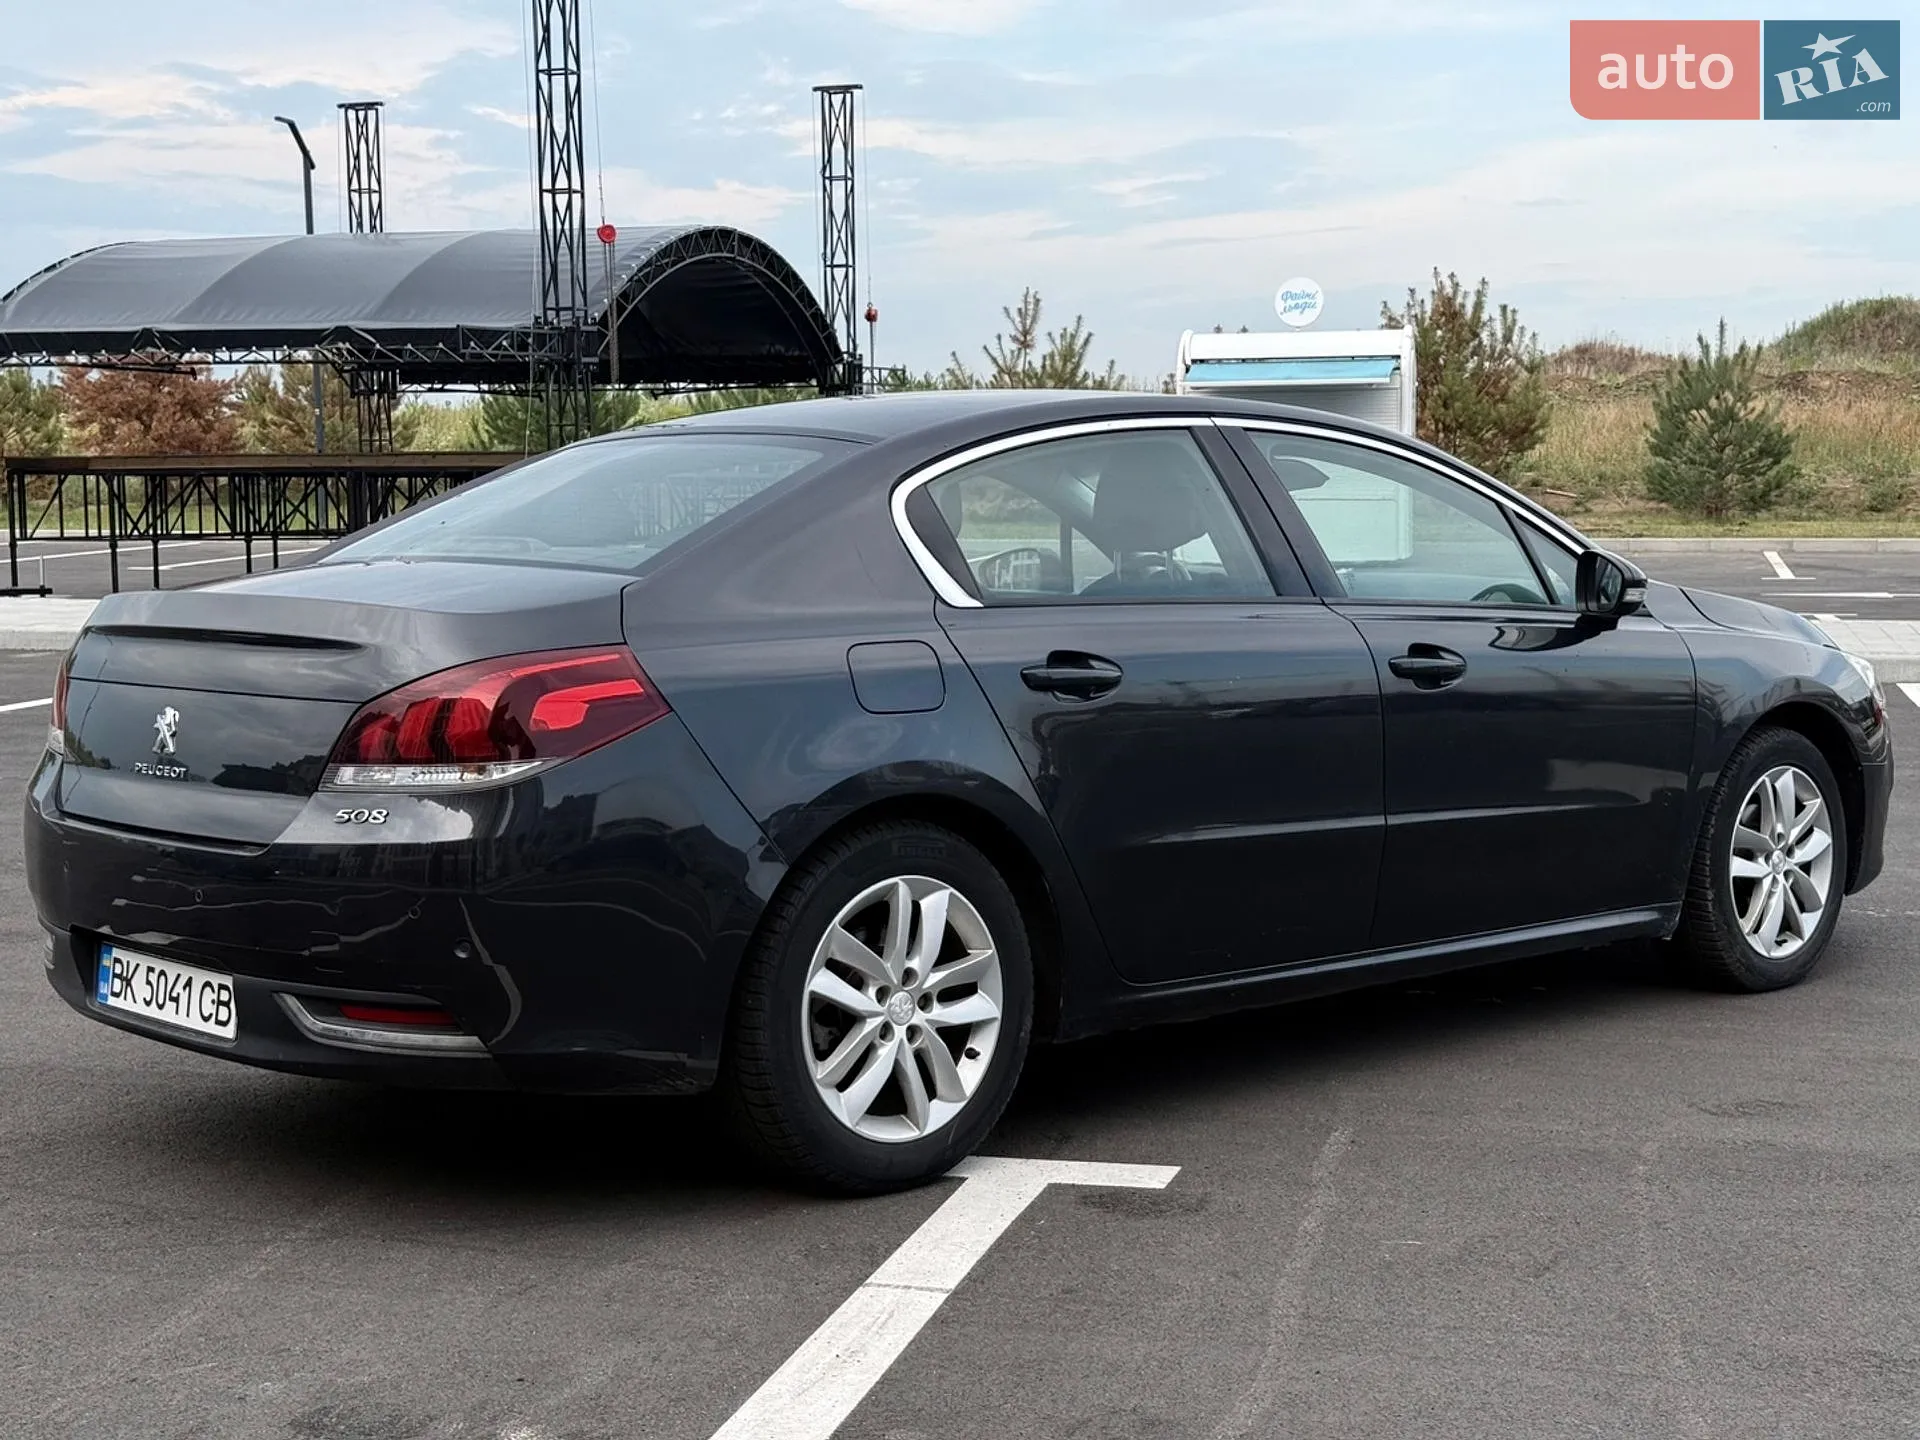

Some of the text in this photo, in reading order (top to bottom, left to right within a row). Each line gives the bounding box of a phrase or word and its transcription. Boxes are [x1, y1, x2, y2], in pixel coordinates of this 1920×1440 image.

[134, 762, 188, 779] PEUGEOT
[333, 808, 389, 825] 508
[110, 956, 232, 1028] BK 5041 CB
